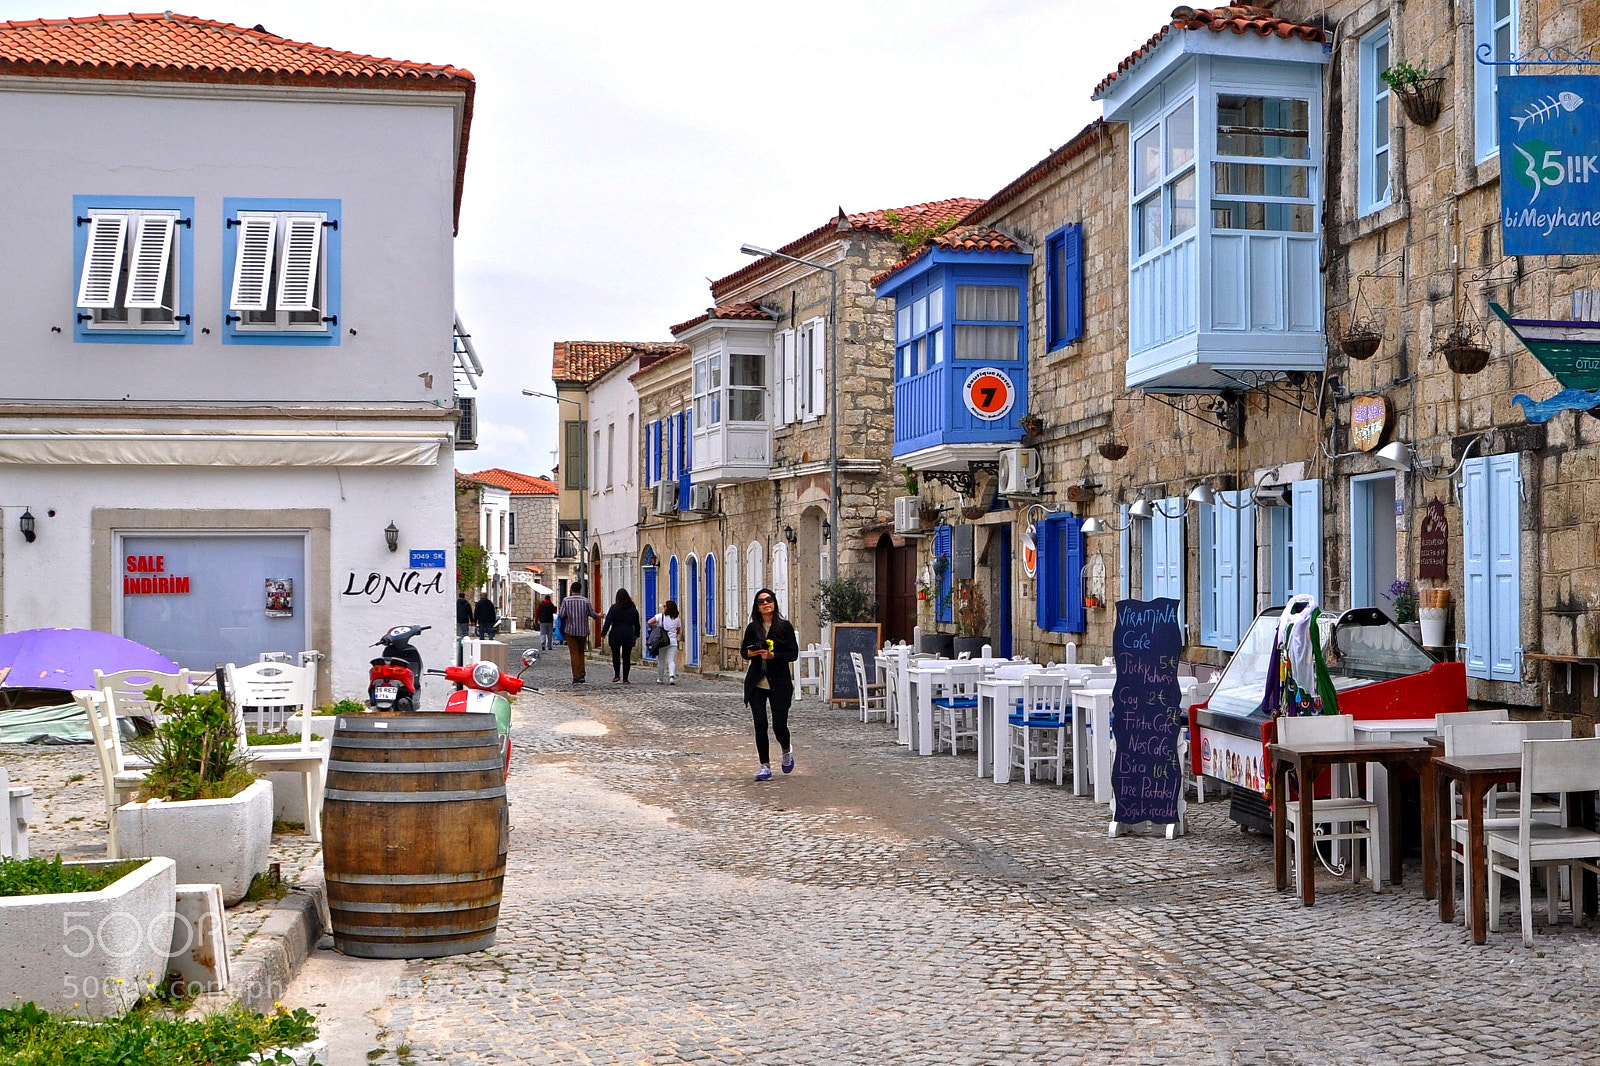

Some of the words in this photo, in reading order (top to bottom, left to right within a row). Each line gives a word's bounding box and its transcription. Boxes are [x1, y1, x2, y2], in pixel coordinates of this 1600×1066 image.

[980, 387, 997, 407] 7
[126, 555, 164, 573] SALE
[342, 570, 445, 604] LONGA
